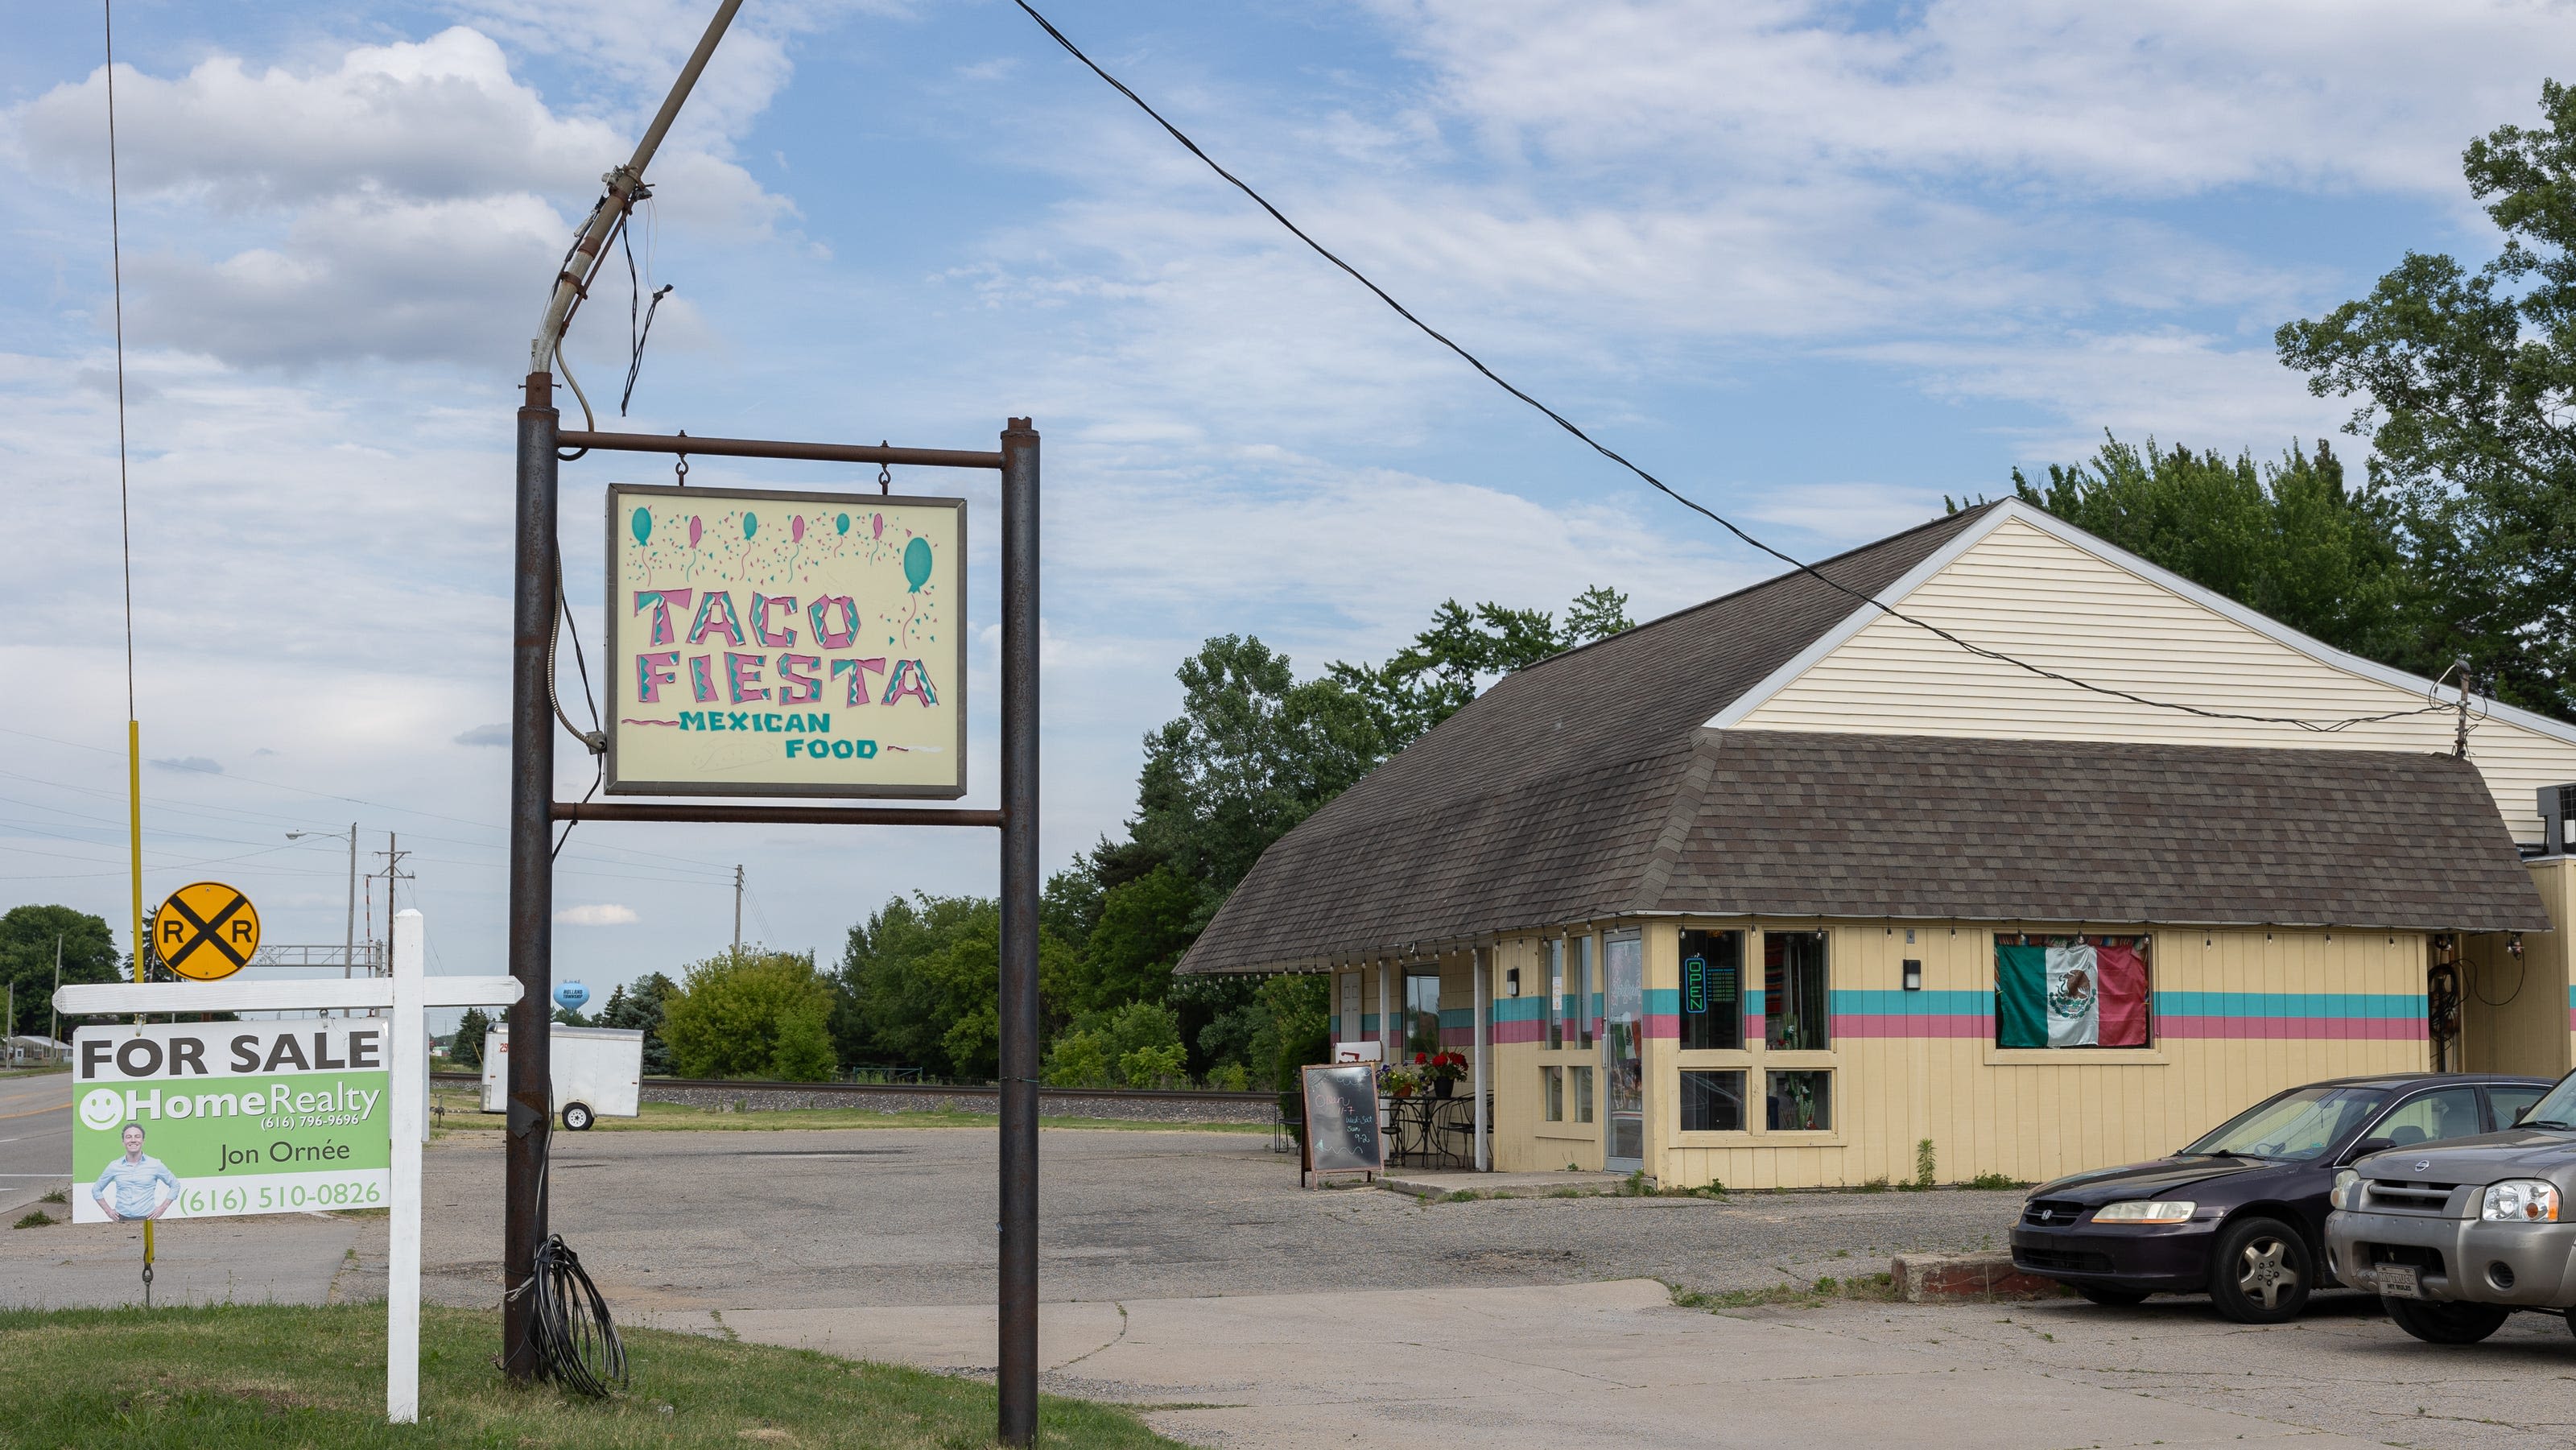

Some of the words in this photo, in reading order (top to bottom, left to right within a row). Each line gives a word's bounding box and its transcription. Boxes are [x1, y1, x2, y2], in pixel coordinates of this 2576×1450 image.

[634, 588, 862, 650] TACO
[636, 651, 940, 708] FIESTA
[679, 711, 831, 733] MEXICAN
[786, 739, 879, 759] FOOD
[163, 920, 184, 944] R
[232, 919, 253, 943] R
[1690, 961, 1703, 1010] OPEN
[81, 1037, 208, 1079] FOR
[230, 1031, 380, 1073] SALE
[126, 1081, 381, 1121] HomeRealty
[260, 1116, 295, 1131] (616)
[299, 1113, 359, 1127] 796-9696
[218, 1144, 258, 1171] Jon
[270, 1139, 350, 1162] Ornée
[180, 1187, 247, 1216] (616)
[258, 1181, 381, 1208] 510-0826
[2389, 1274, 2416, 1284] TRUCK
